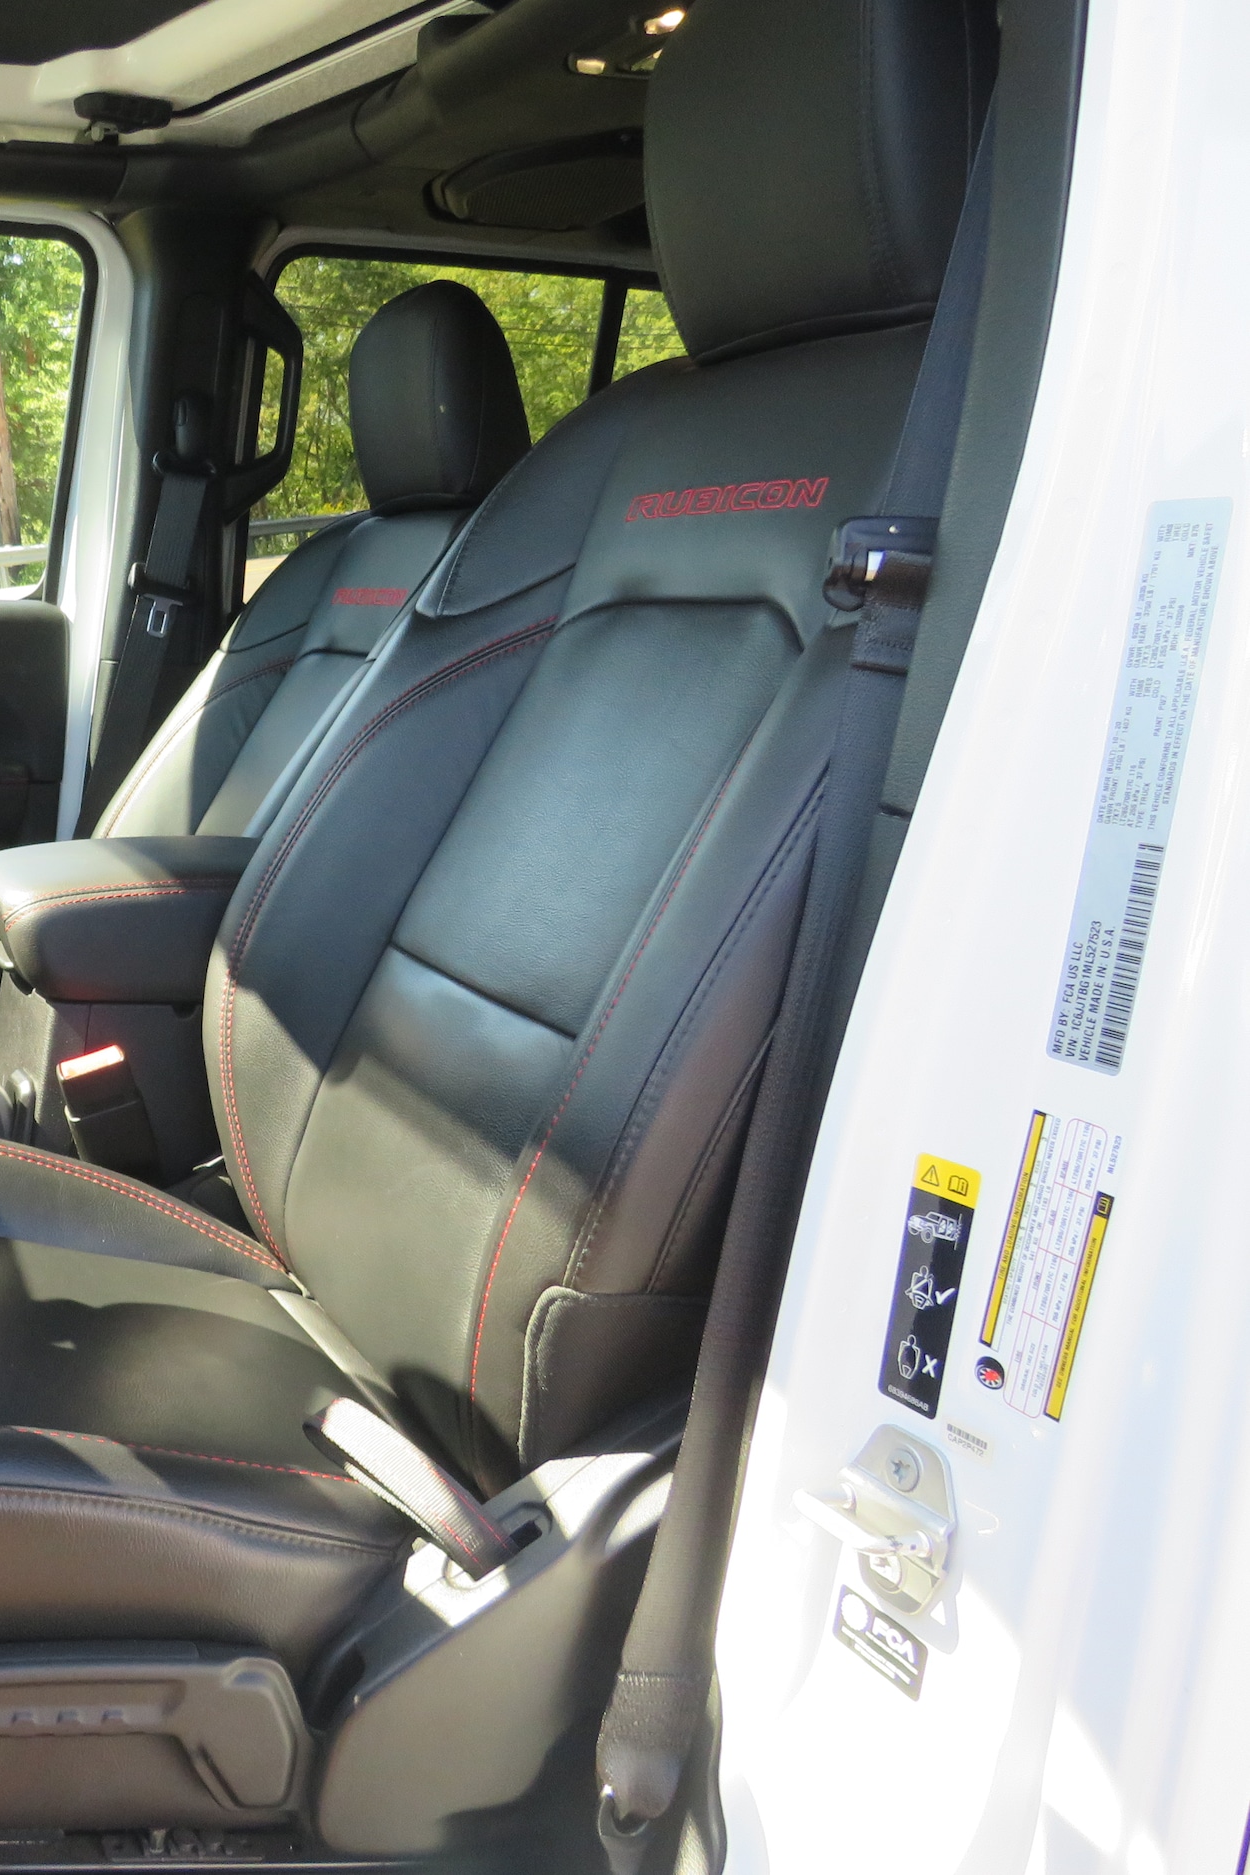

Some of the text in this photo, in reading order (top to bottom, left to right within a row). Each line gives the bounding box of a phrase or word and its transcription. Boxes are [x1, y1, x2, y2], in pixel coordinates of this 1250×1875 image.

[625, 477, 830, 523] RUBICON
[1172, 523, 1181, 541] TIRE
[1197, 547, 1209, 576] VEHICLE
[330, 586, 410, 608] RUBICON
[1191, 580, 1202, 605] MOTOR
[1202, 572, 1214, 599] SHOWN
[1184, 608, 1197, 641] FEDERAL
[1191, 602, 1208, 657] MANUFACTURE
[1188, 660, 1196, 669] OF
[1170, 669, 1185, 712] APPLICABLE
[1184, 671, 1194, 690] DATE
[1181, 693, 1189, 706] THE
[1167, 714, 1176, 727] ALL
[1178, 709, 1186, 720] ON
[1165, 729, 1173, 739] TO
[1173, 723, 1184, 748] EFFECT
[1157, 741, 1171, 781] CONFORMS
[1162, 761, 1176, 804] STANDARDS
[1151, 783, 1162, 812] VEHICLE
[1148, 814, 1156, 830] THIS
[1053, 941, 1083, 1054] MFD BY: FCA US LLC
[1079, 924, 1114, 1062] VEHICLE MADE IN: U.S.A.
[1066, 1034, 1078, 1058] VIN:
[1106, 1134, 1122, 1174] ML527523
